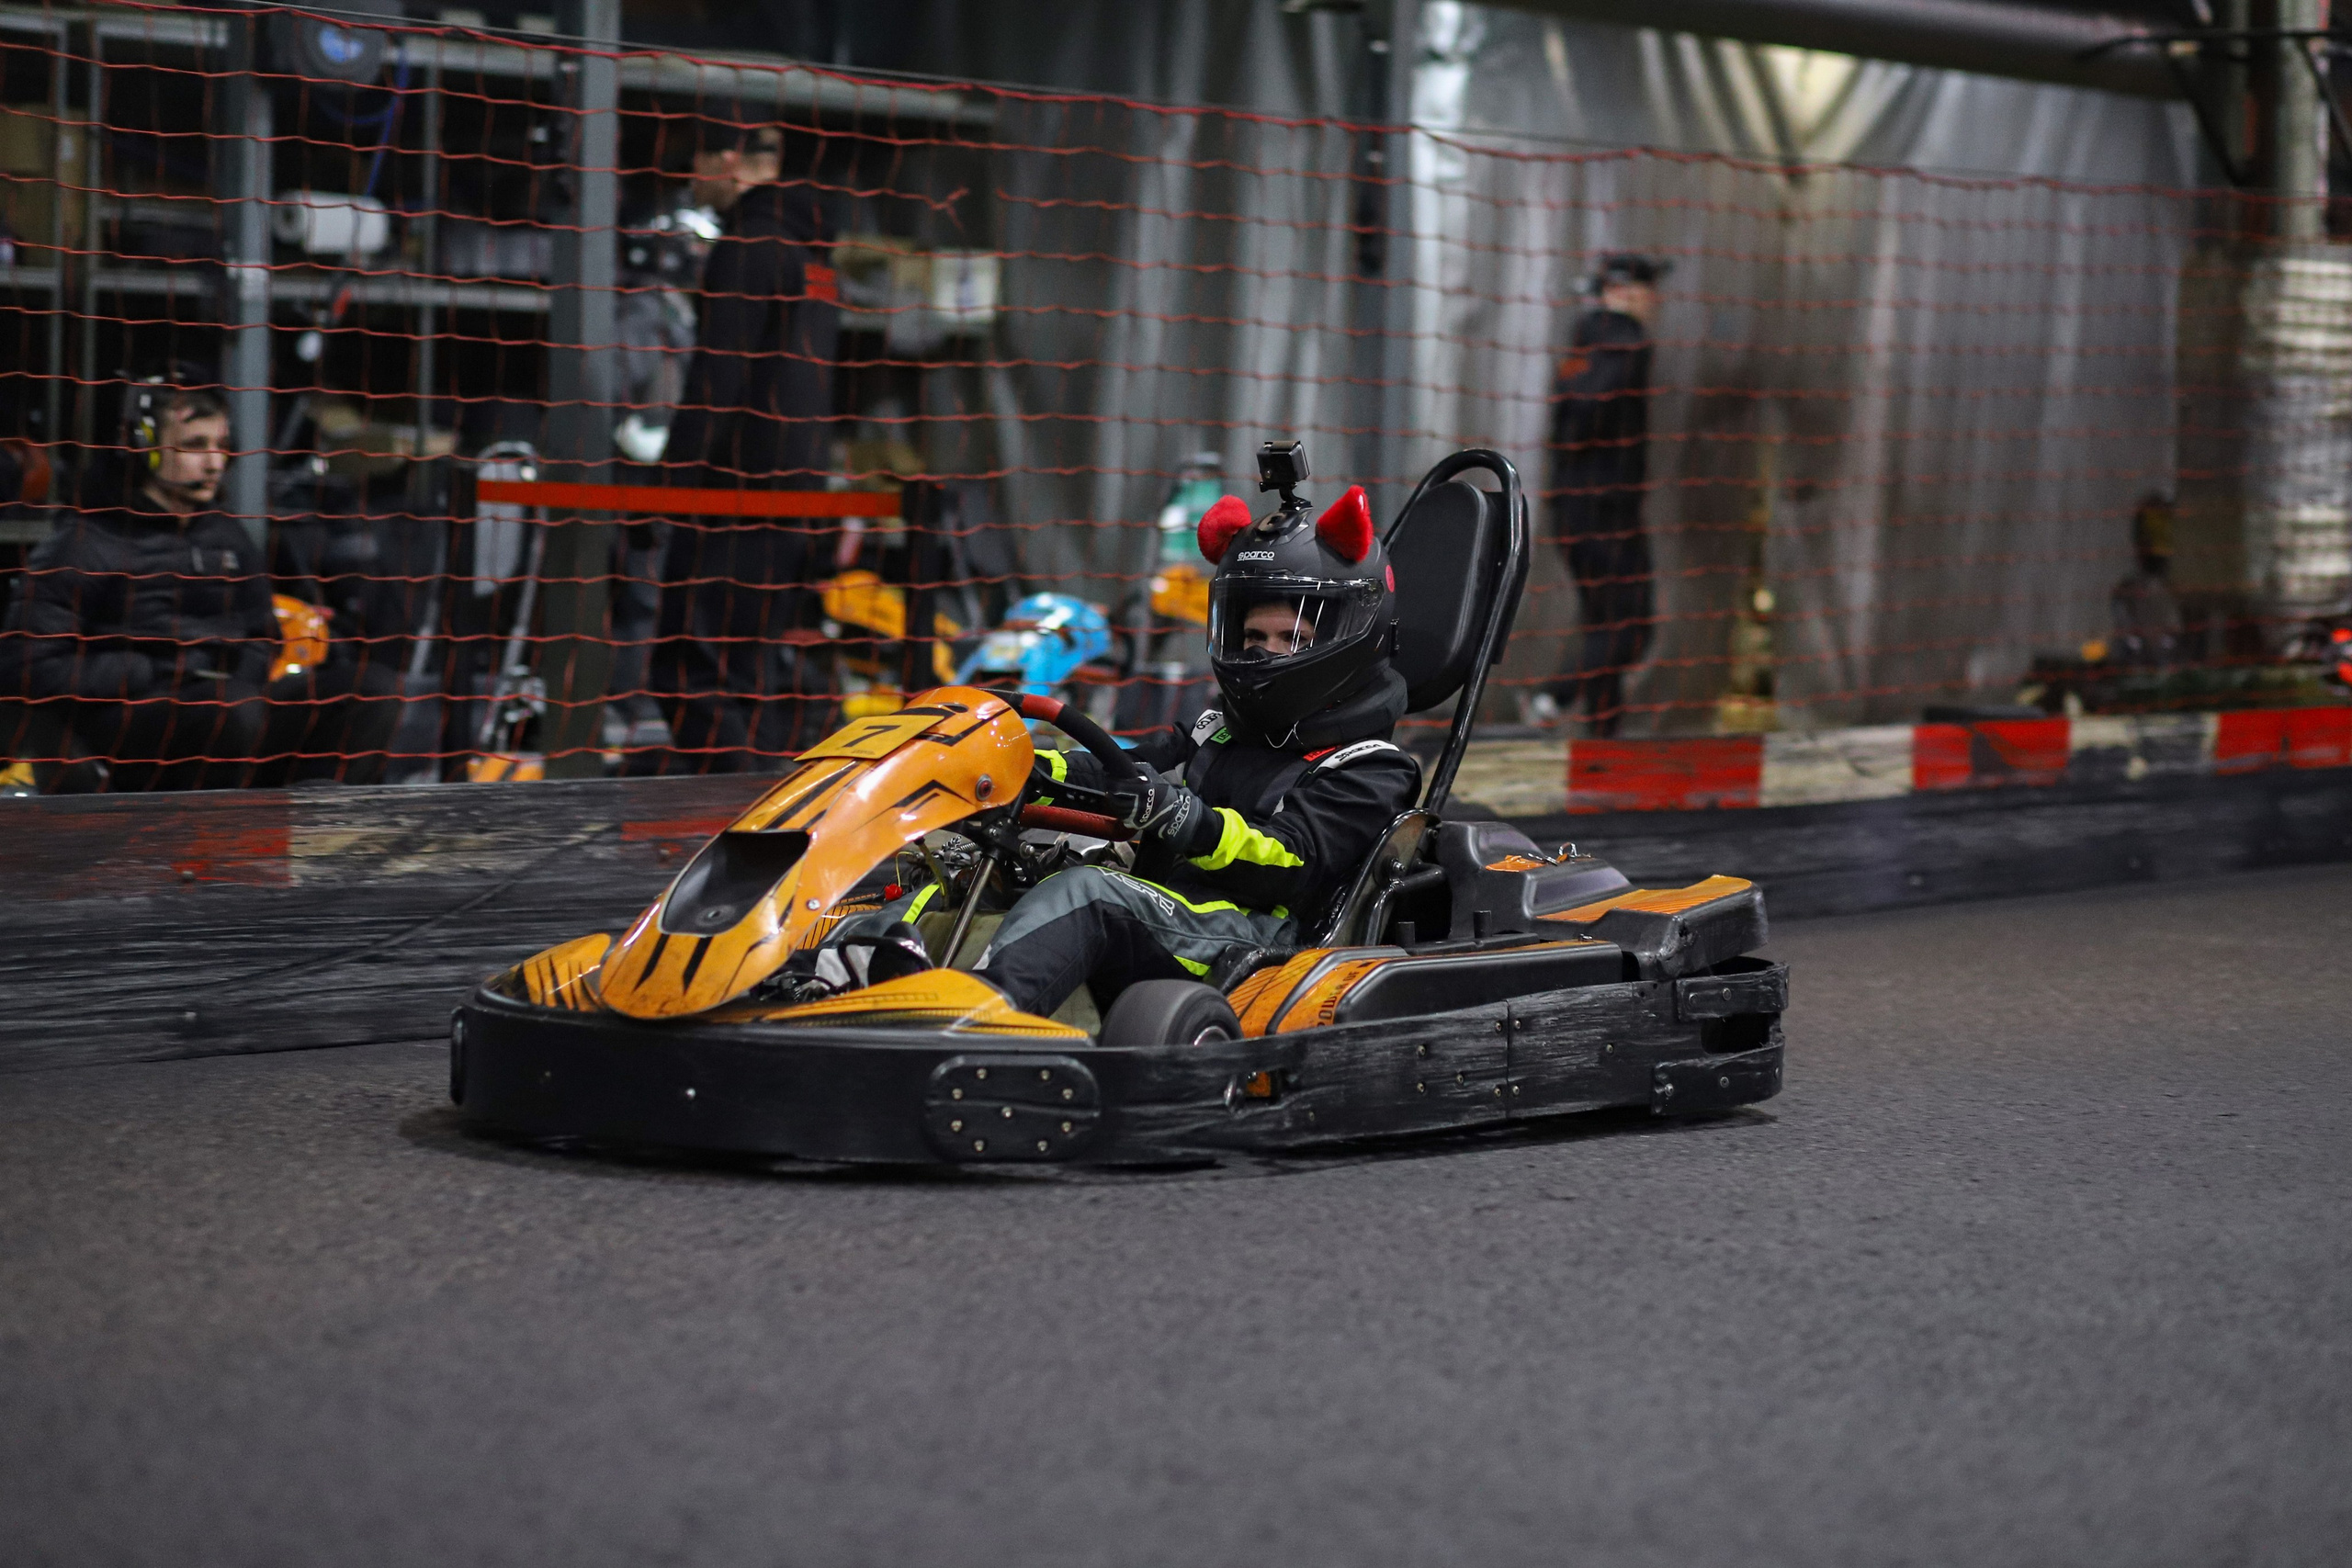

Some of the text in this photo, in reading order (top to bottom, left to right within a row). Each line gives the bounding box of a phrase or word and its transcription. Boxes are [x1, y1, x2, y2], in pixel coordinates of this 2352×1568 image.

[1237, 550, 1275, 561] sparco
[1196, 712, 1222, 729] arco
[842, 724, 902, 748] 7
[1139, 788, 1155, 823] sparco
[1167, 795, 1192, 838] sparco
